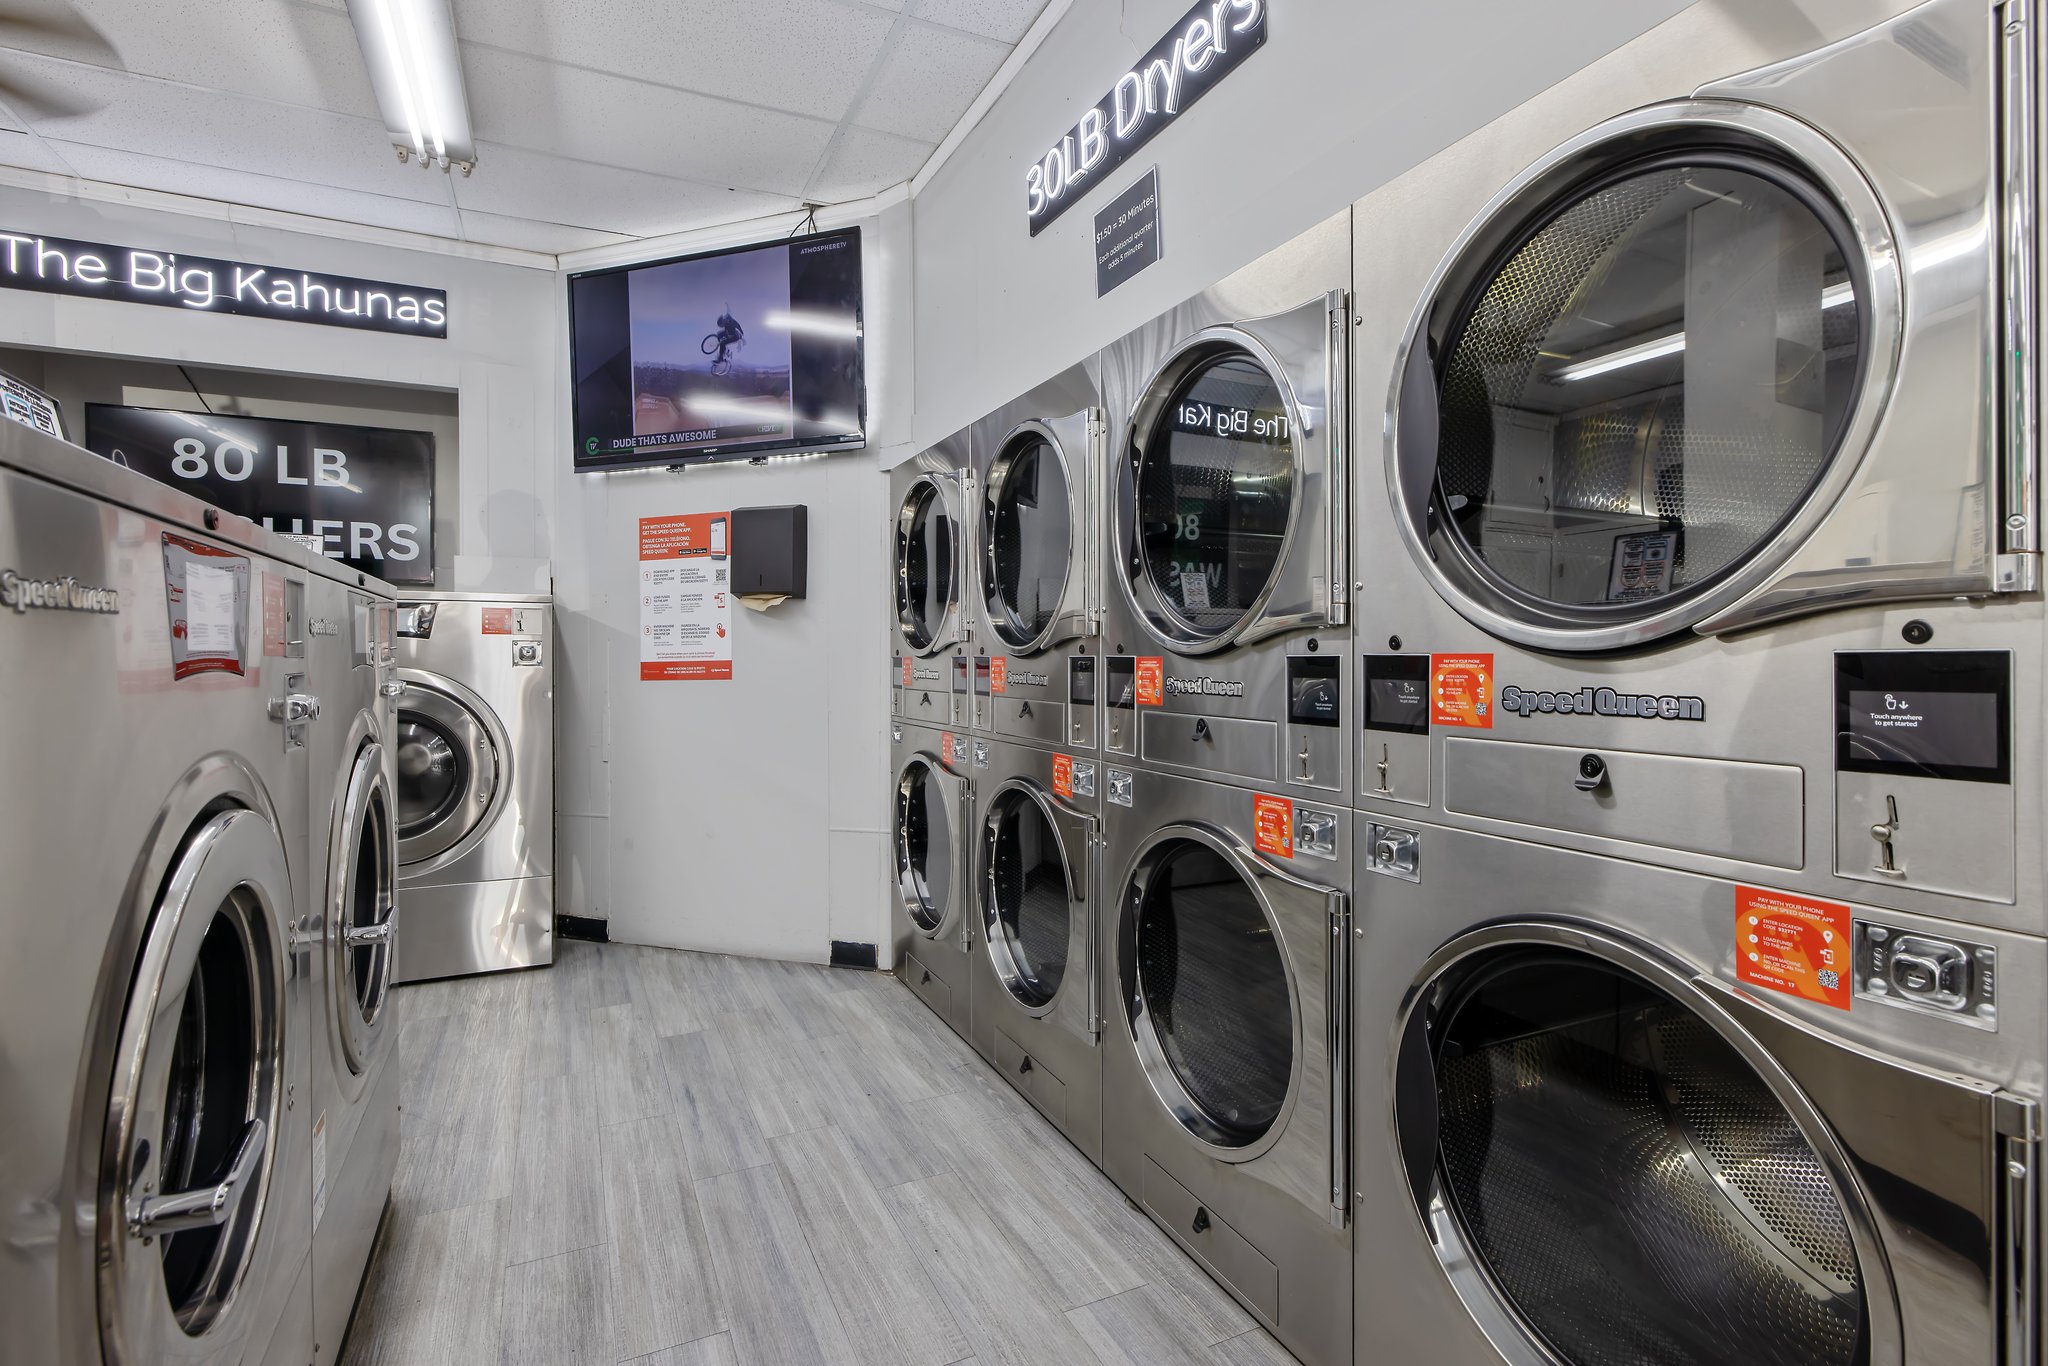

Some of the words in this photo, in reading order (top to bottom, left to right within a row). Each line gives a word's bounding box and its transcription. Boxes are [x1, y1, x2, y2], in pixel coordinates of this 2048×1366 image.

[1026, 108, 1109, 215] 30LB
[1115, 0, 1264, 138] Dryers
[1096, 224, 1112, 244] $1.50
[1118, 214, 1126, 227] 30
[1128, 194, 1154, 220] Minutes
[1098, 252, 1110, 264] Each
[1110, 234, 1133, 256] additional
[1134, 221, 1153, 239] quarter
[1108, 258, 1120, 270] adds
[1120, 254, 1124, 262] 5
[1124, 242, 1144, 259] minutes
[0, 233, 108, 284] The
[130, 251, 214, 307] Big
[235, 267, 446, 326] Kahunas
[613, 437, 636, 448] DUDE
[638, 434, 667, 446] THATS
[669, 430, 716, 443] AWESOME
[172, 438, 255, 482] 80
[277, 445, 351, 488] LB
[0, 569, 69, 614] Speed
[69, 577, 119, 614] Queen
[913, 668, 926, 680] Speed
[1007, 671, 1026, 686] Speed
[1026, 672, 1048, 686] Queen
[1166, 676, 1202, 696] Speed
[1202, 677, 1244, 697] Queen
[1502, 686, 1594, 717] Speed
[1595, 687, 1705, 721] Queen
[1749, 901, 1766, 909] USING
[1780, 908, 1798, 916] SPEED
[1803, 906, 1824, 915] PHONE
[1779, 922, 1803, 931] LOCATION
[1779, 958, 1800, 967] MACHINE
[1750, 972, 1774, 982] MACHINE
